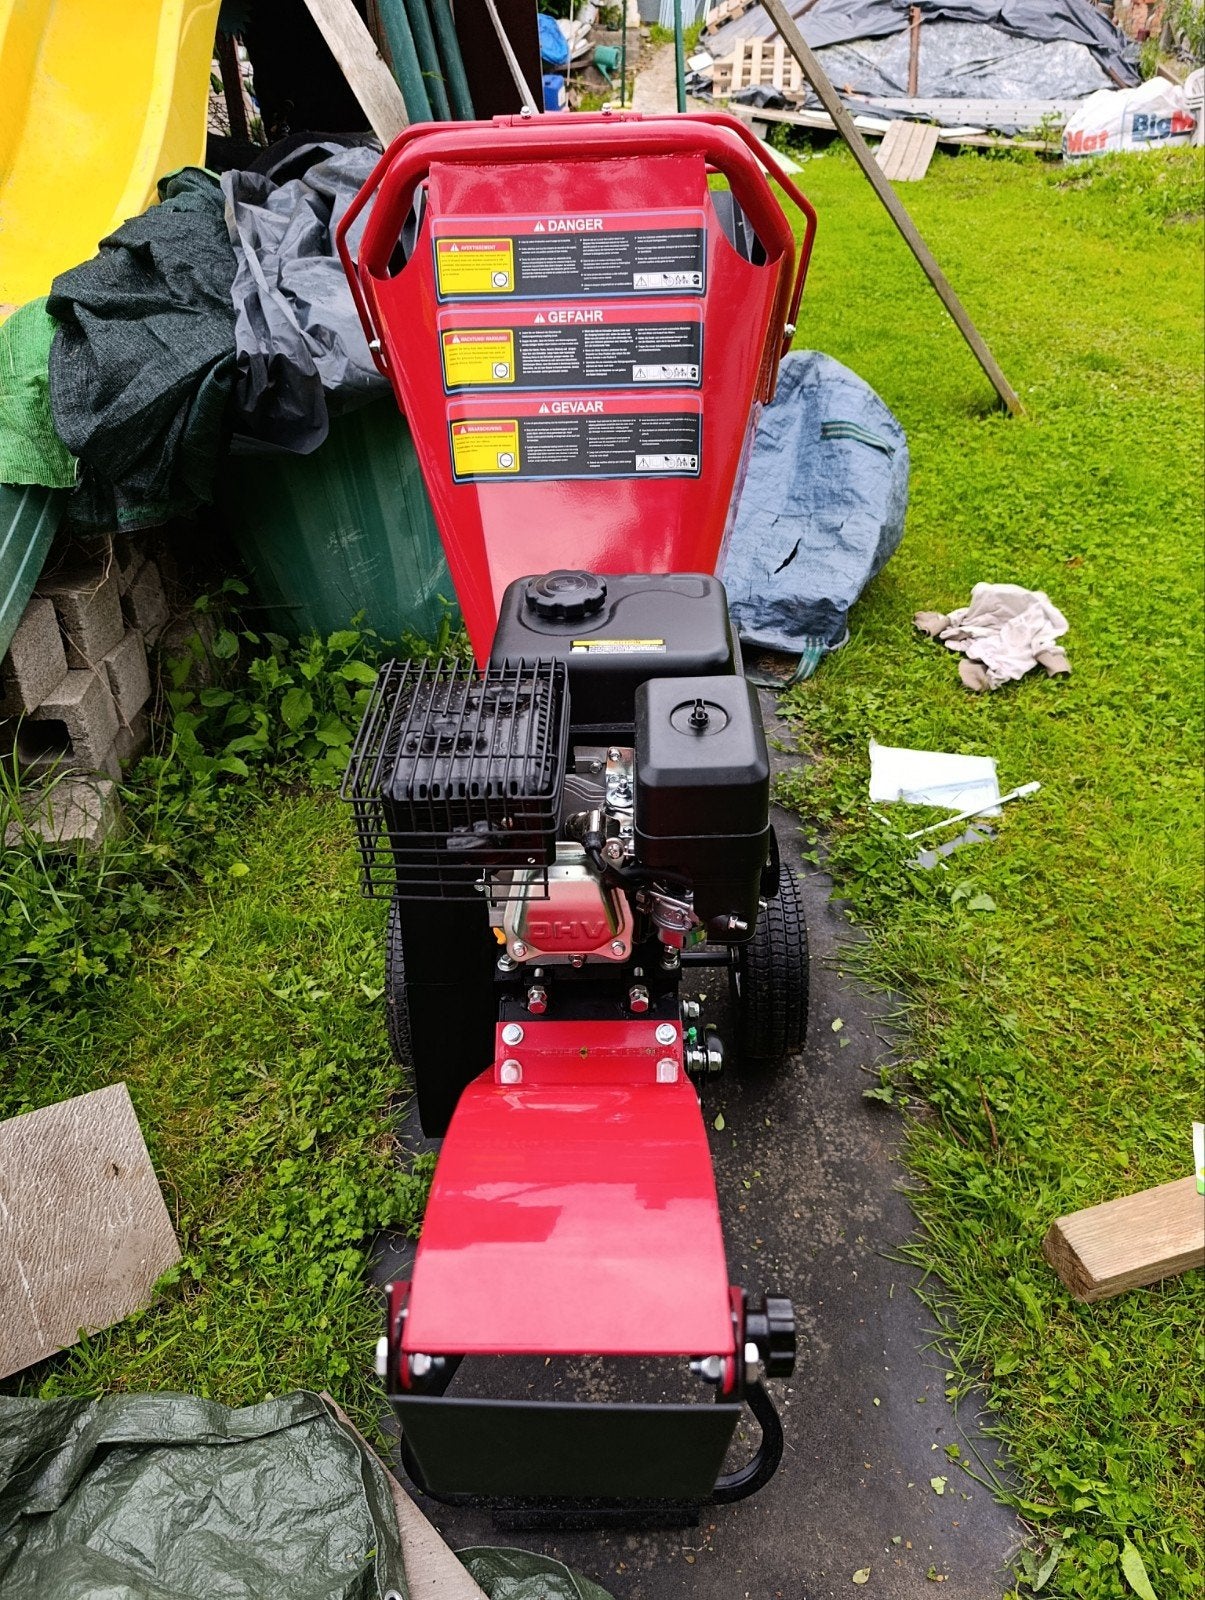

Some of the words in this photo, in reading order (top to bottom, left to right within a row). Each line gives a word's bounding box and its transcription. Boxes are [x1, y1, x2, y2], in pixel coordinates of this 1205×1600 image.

[1067, 130, 1109, 153] Mat
[547, 218, 604, 232] DANGER
[547, 310, 604, 323] GEFAHR
[551, 401, 605, 414] GEVAAR
[528, 921, 606, 940] OHV
